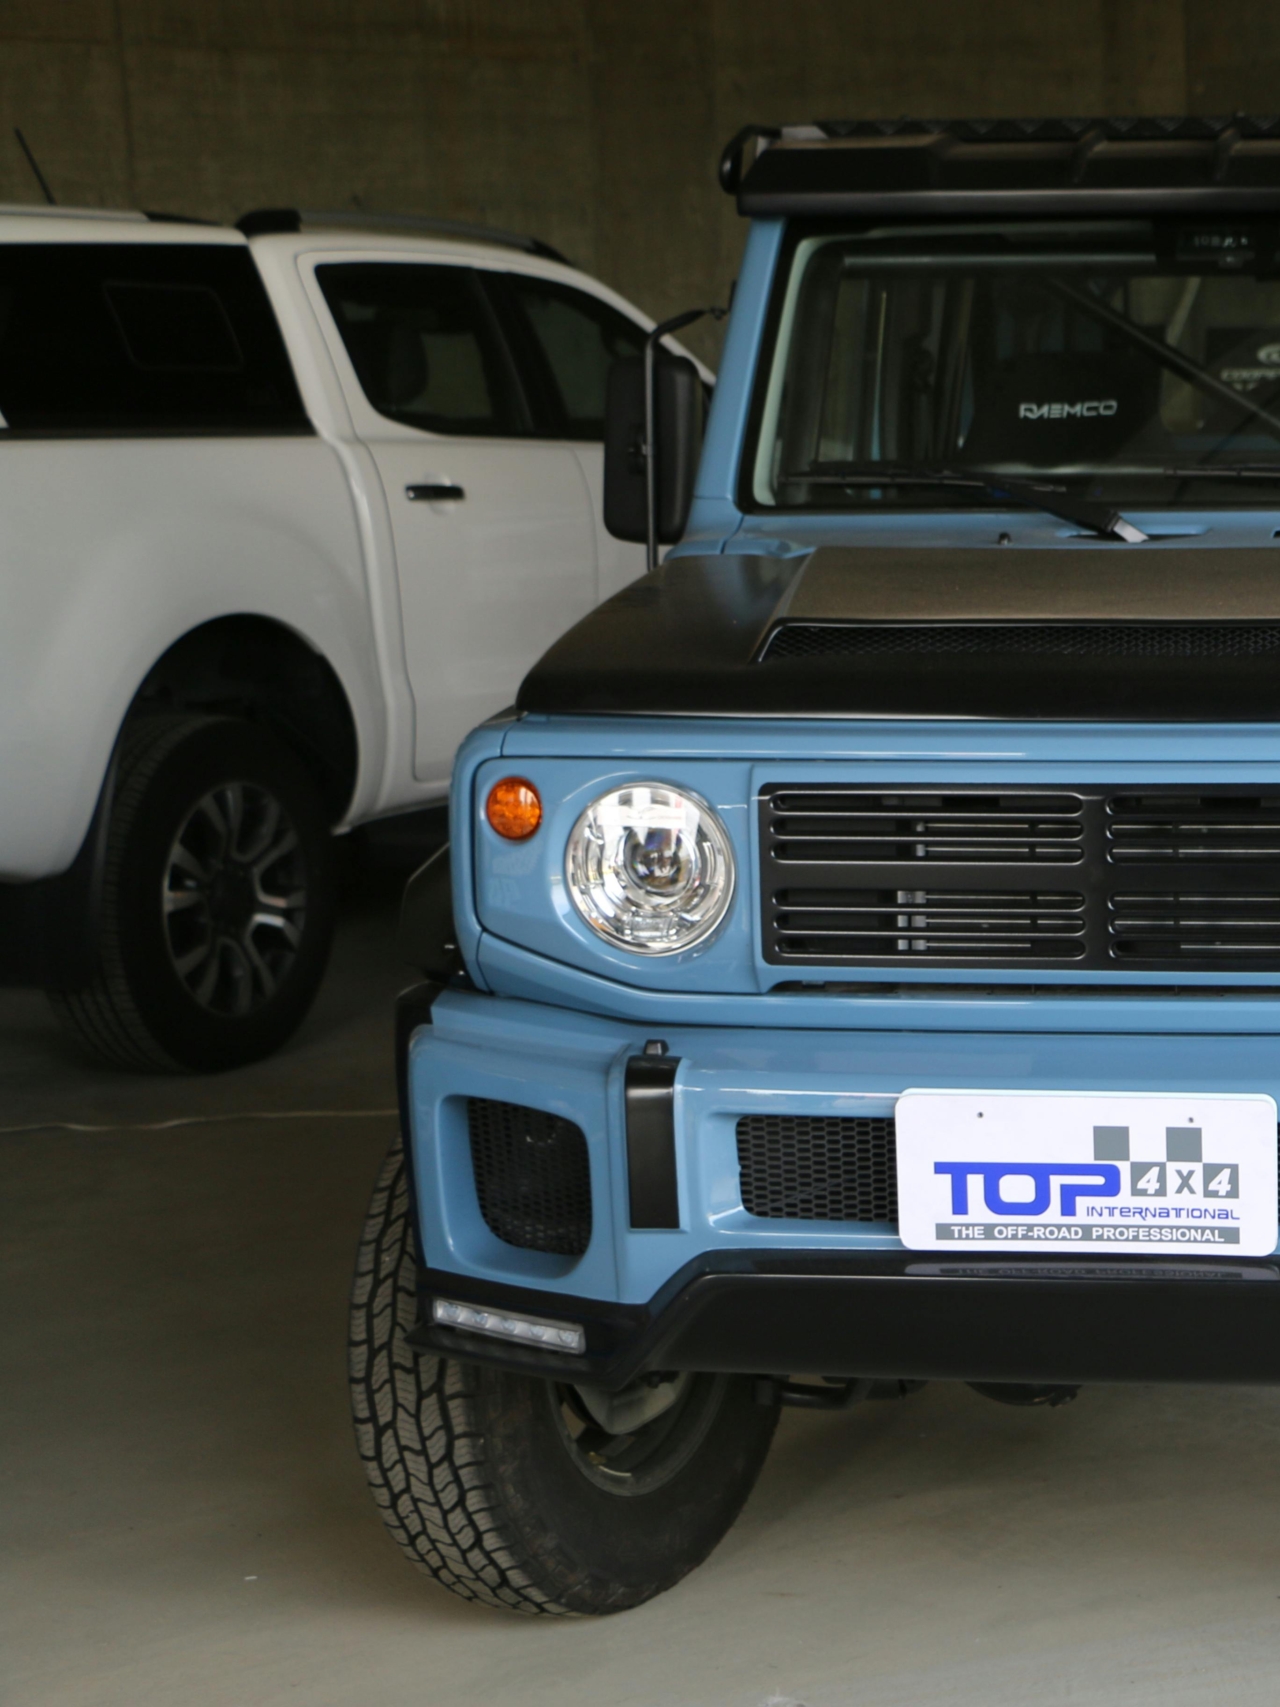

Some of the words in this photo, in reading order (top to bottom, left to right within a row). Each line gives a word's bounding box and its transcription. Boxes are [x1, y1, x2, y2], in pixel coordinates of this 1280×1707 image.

[1018, 399, 1118, 421] RAEMCO
[933, 1161, 1121, 1217] TOP
[950, 1226, 985, 1239] THE
[993, 1226, 1083, 1241] OFF-ROAD
[1092, 1228, 1226, 1243] PROFESSIONAL
